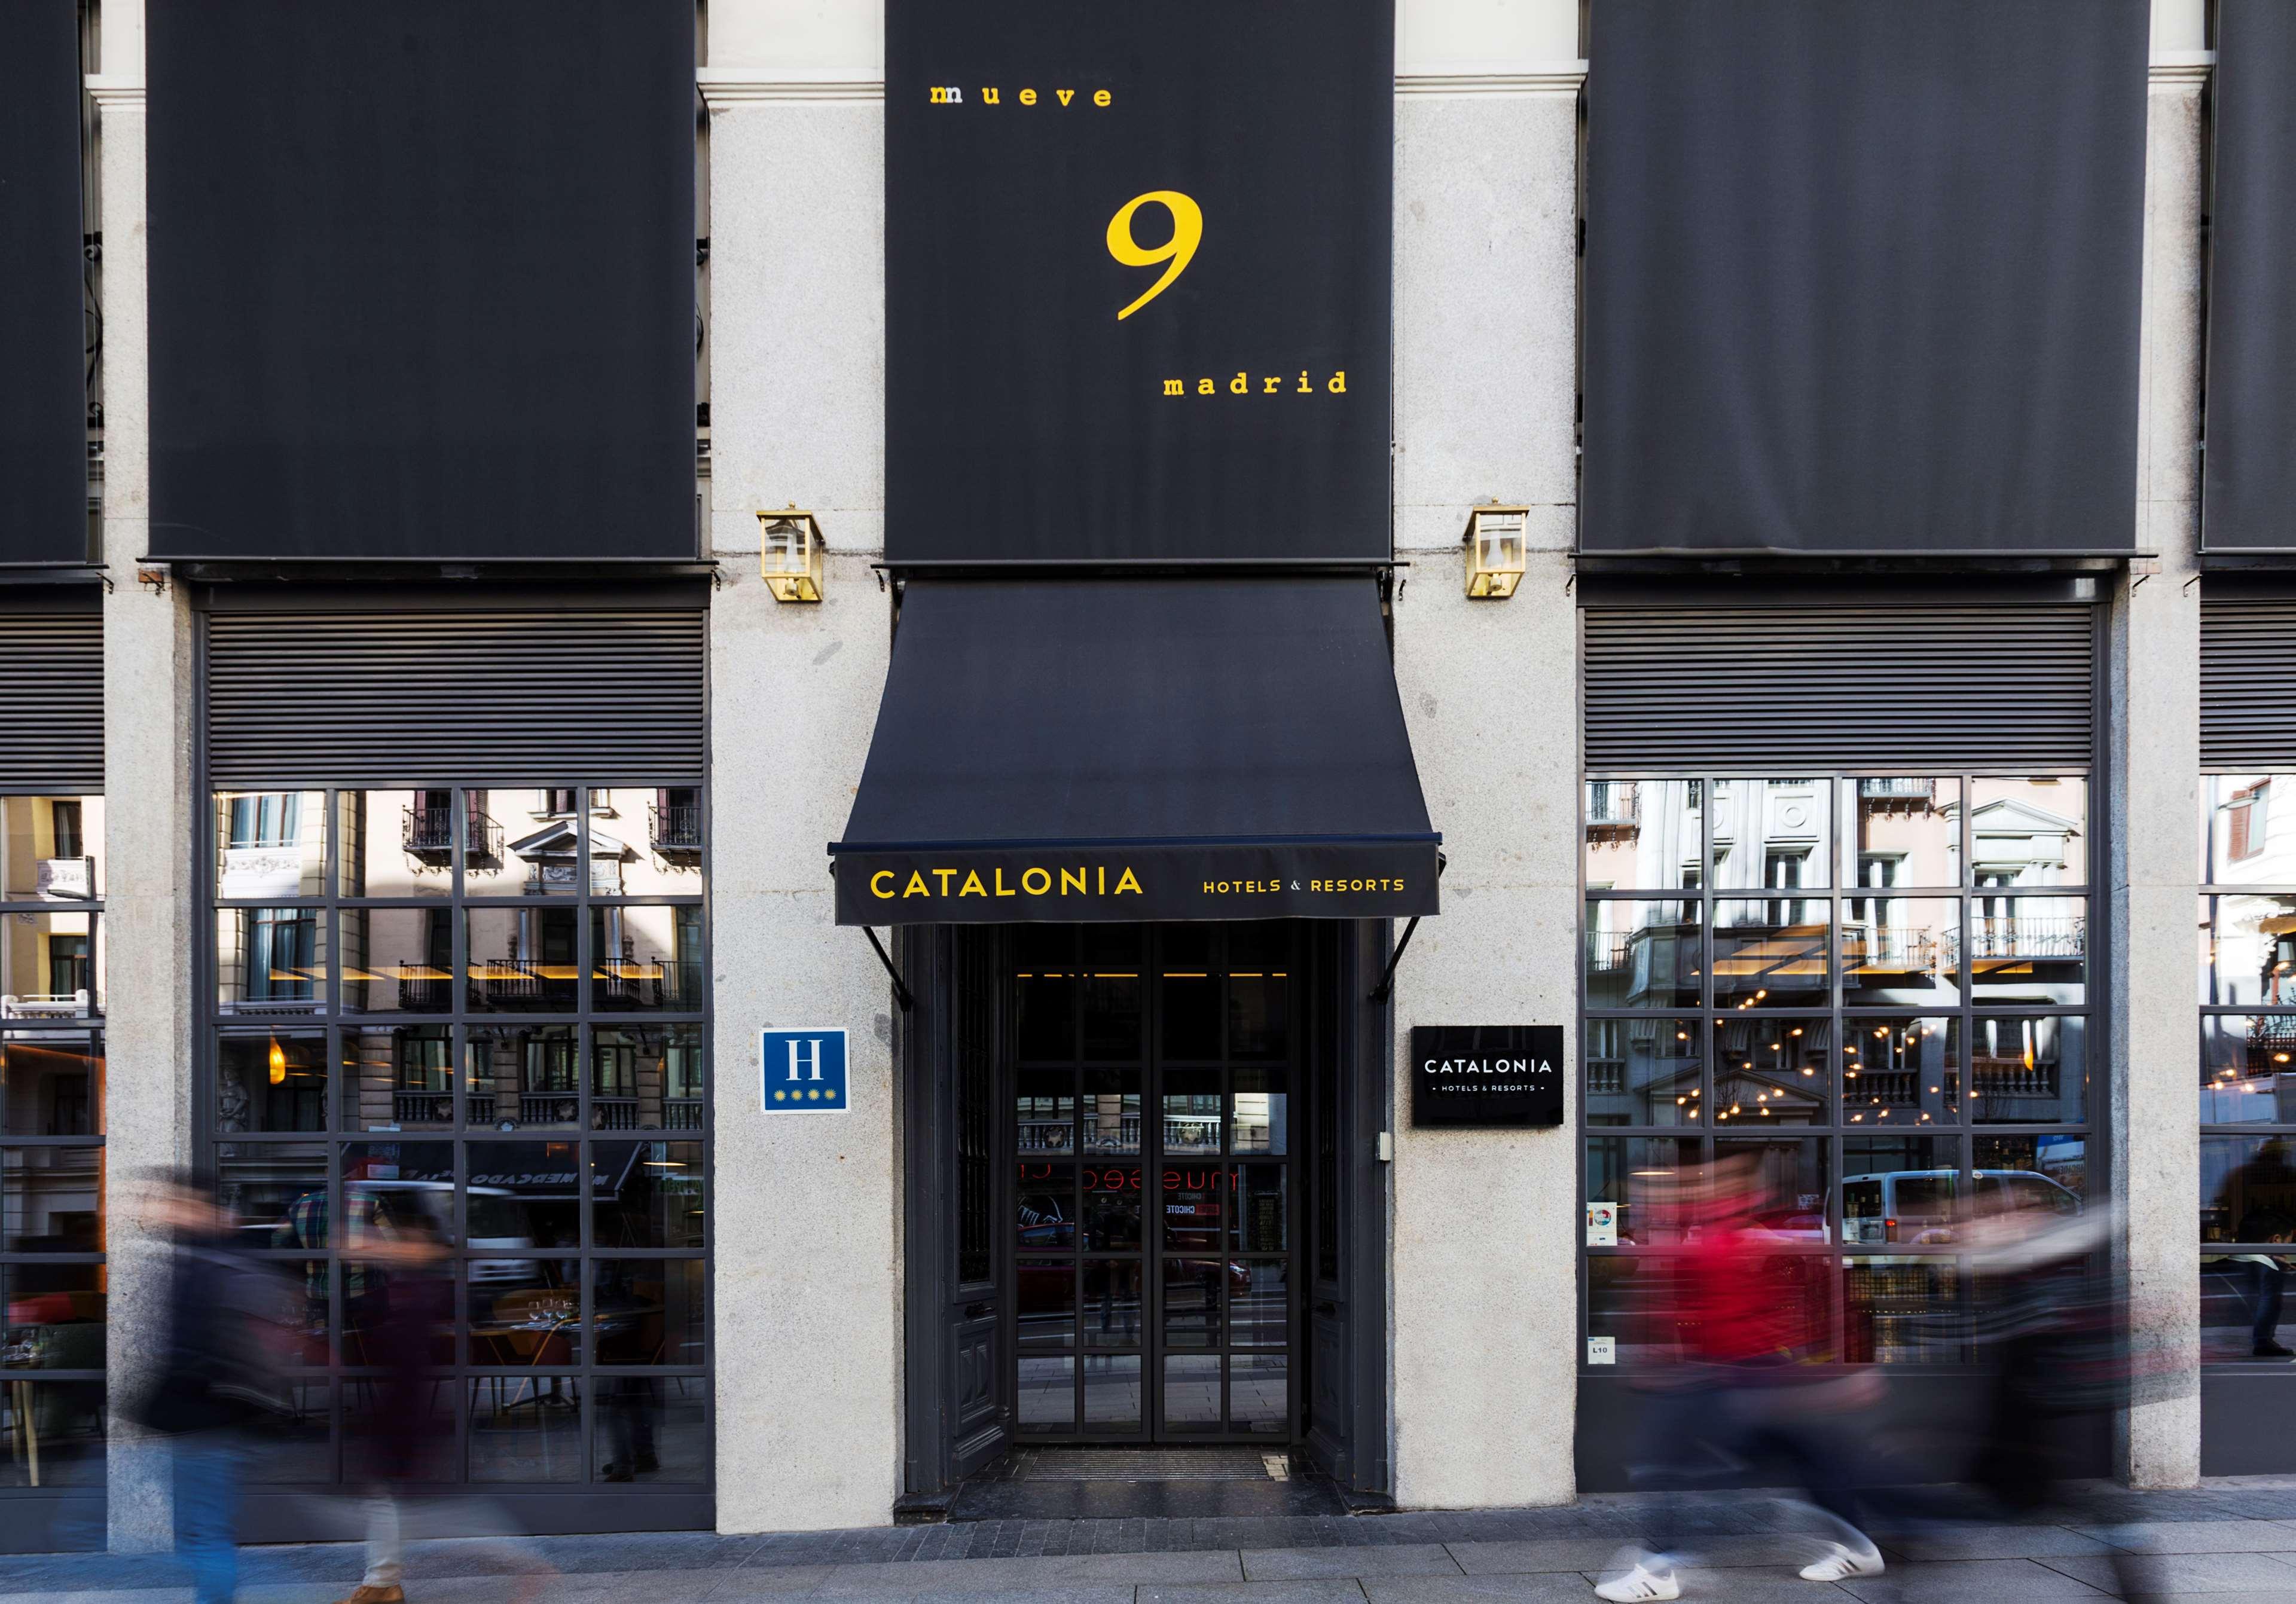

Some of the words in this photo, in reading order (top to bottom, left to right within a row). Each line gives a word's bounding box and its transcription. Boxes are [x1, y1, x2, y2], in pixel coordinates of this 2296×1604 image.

[1106, 190, 1203, 321] 9
[1163, 370, 1347, 396] madrid
[870, 866, 1143, 899] CATALONIA
[1204, 879, 1280, 893] HOTELS
[1290, 880, 1300, 890] &
[1311, 878, 1404, 892] RESORTS
[785, 1040, 824, 1081] H
[1424, 1059, 1552, 1073] CATALONIA
